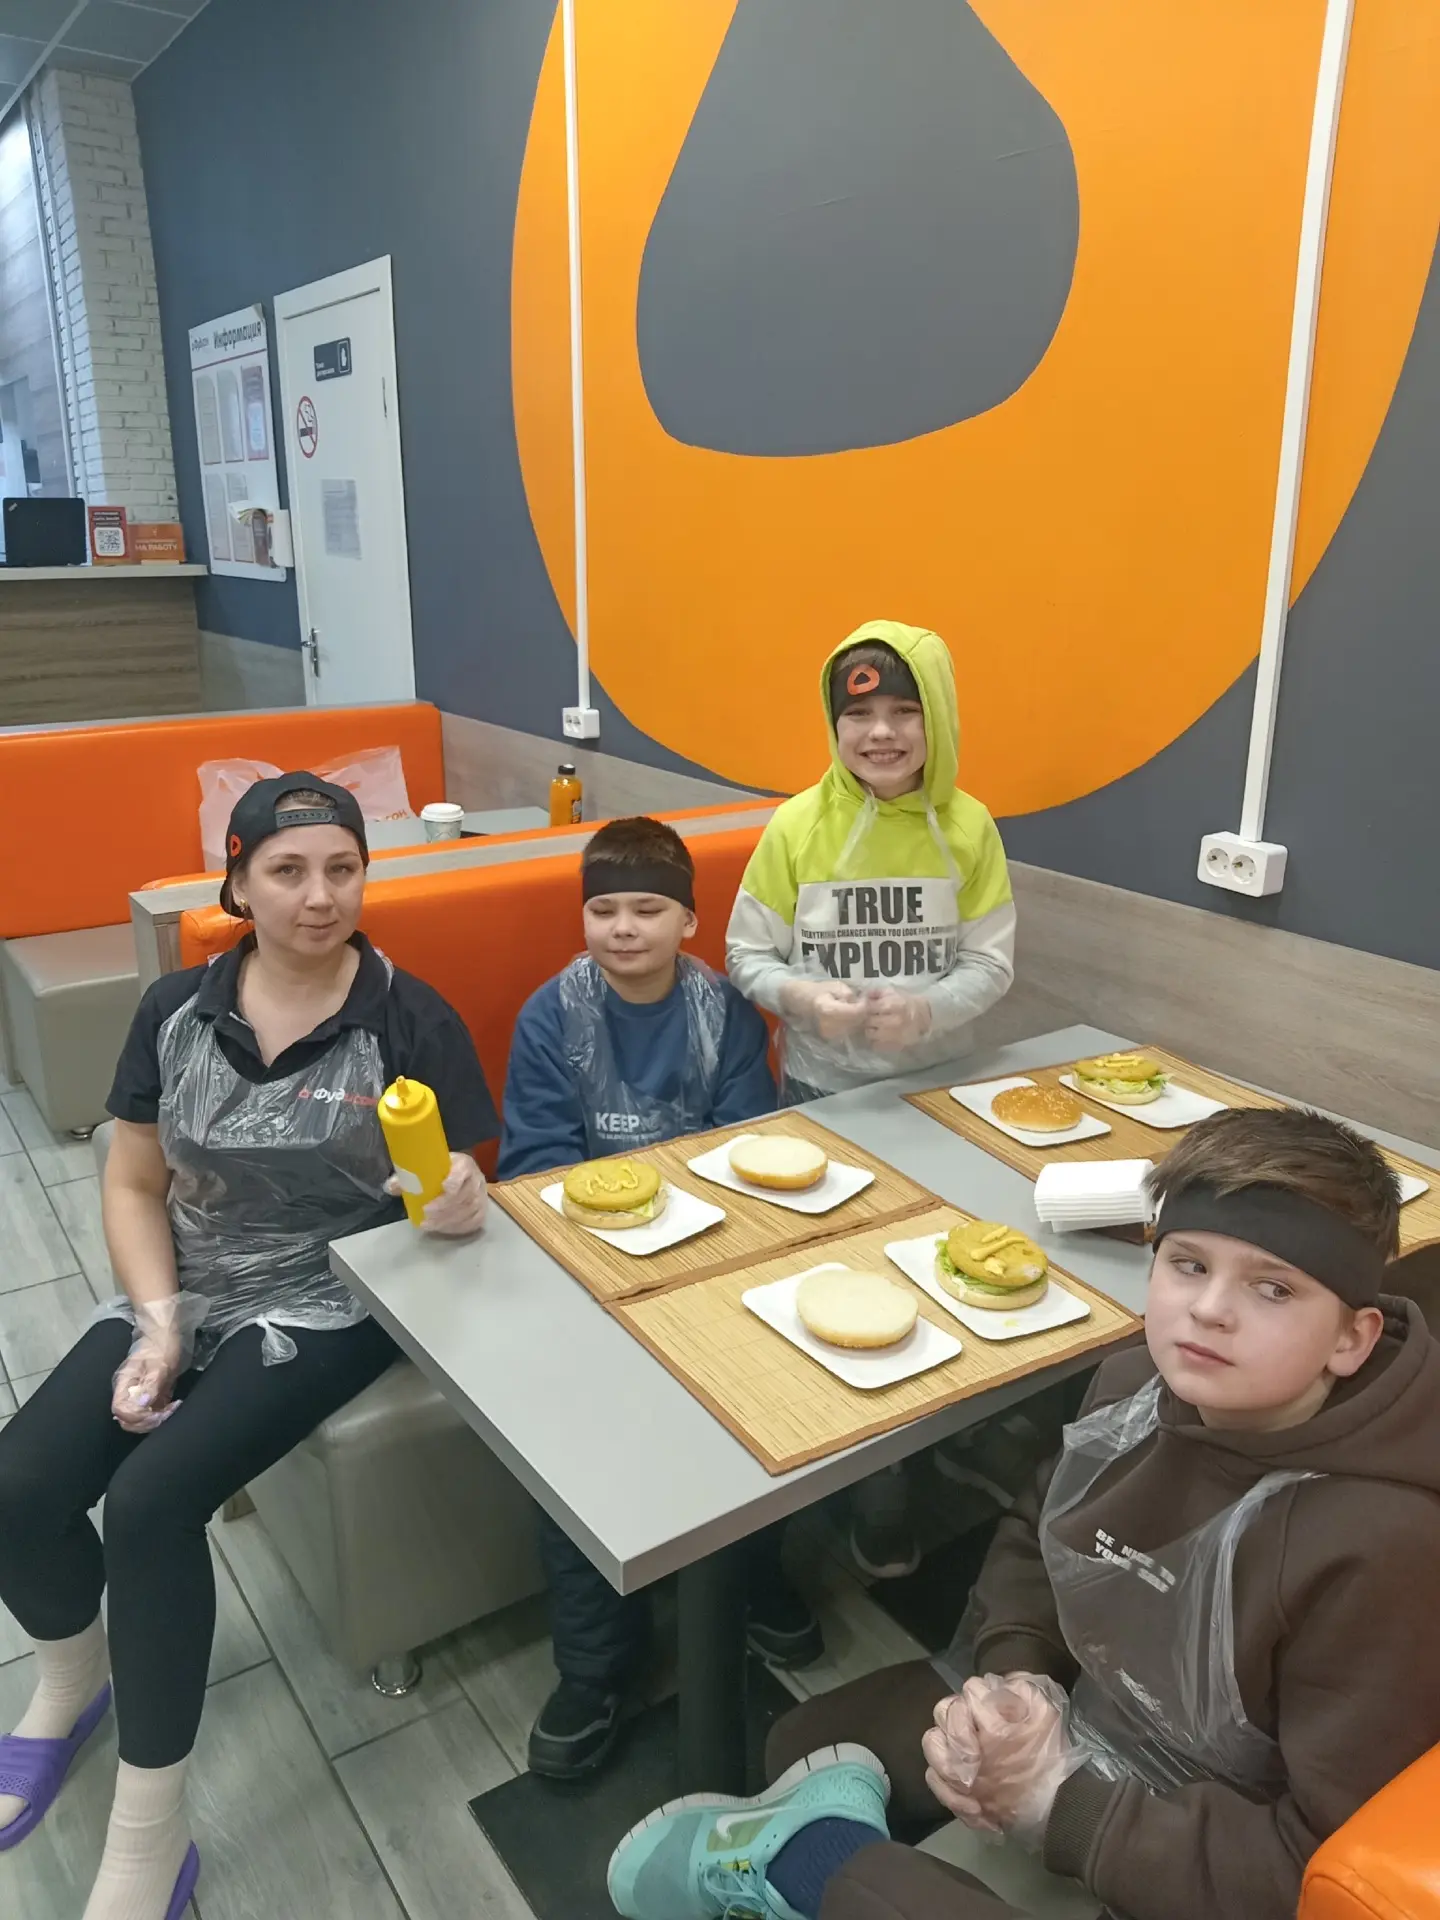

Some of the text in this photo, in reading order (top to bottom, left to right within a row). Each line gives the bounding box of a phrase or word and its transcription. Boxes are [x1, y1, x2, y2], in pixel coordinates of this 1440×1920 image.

[832, 886, 923, 925] TRUE
[837, 928, 867, 937] CHANGES
[868, 928, 886, 937] WHEN
[888, 928, 901, 937] YOU
[902, 928, 917, 937] LOOK
[595, 1112, 640, 1132] KEEP
[1096, 1528, 1115, 1548] BE
